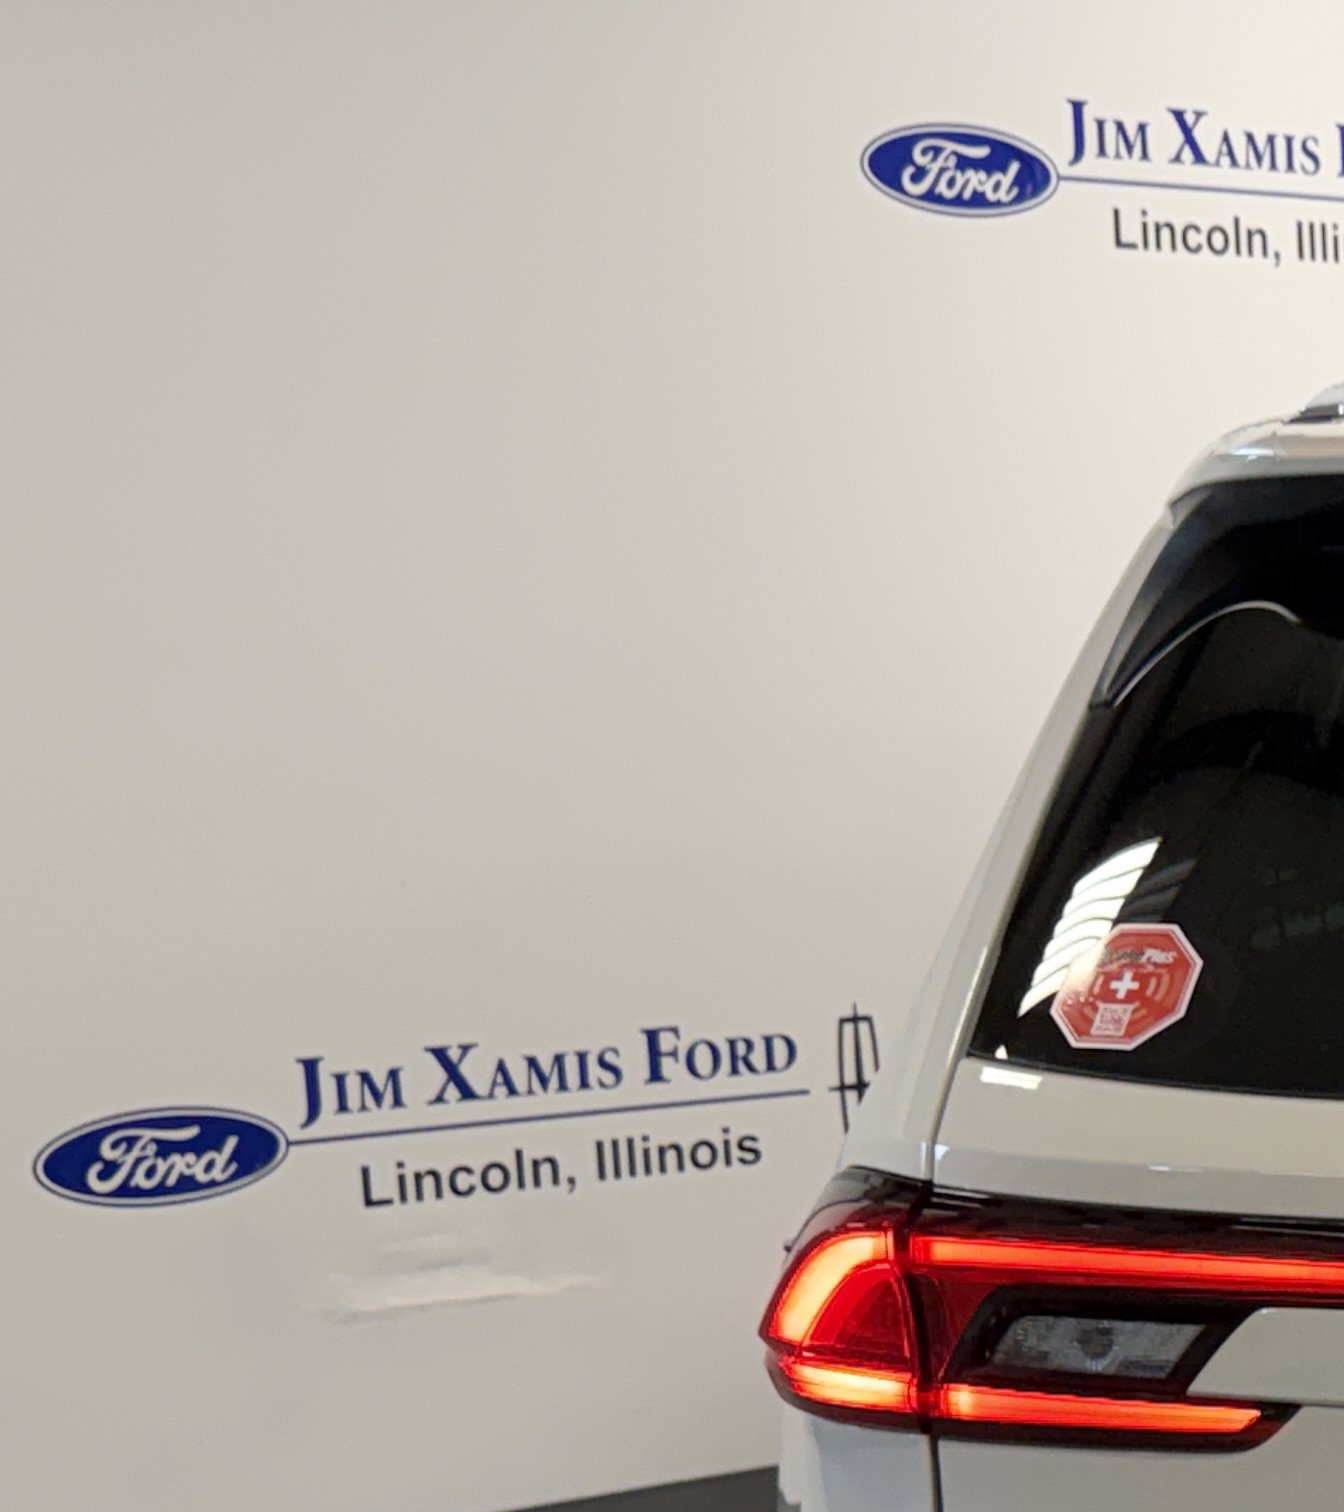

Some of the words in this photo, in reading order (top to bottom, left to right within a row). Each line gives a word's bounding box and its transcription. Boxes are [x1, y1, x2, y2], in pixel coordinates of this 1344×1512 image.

[901, 138, 1019, 204] Ford
[1066, 98, 1150, 166] JIM
[1166, 106, 1321, 176] XAMIS
[1113, 207, 1281, 267] Lincoln,
[295, 1056, 406, 1128] JIM
[424, 1043, 624, 1105] XAMIS
[640, 1025, 798, 1084] FORD
[86, 1125, 237, 1195] Ford
[360, 1149, 577, 1208] Lincoln,
[596, 1126, 763, 1183] Illinois
